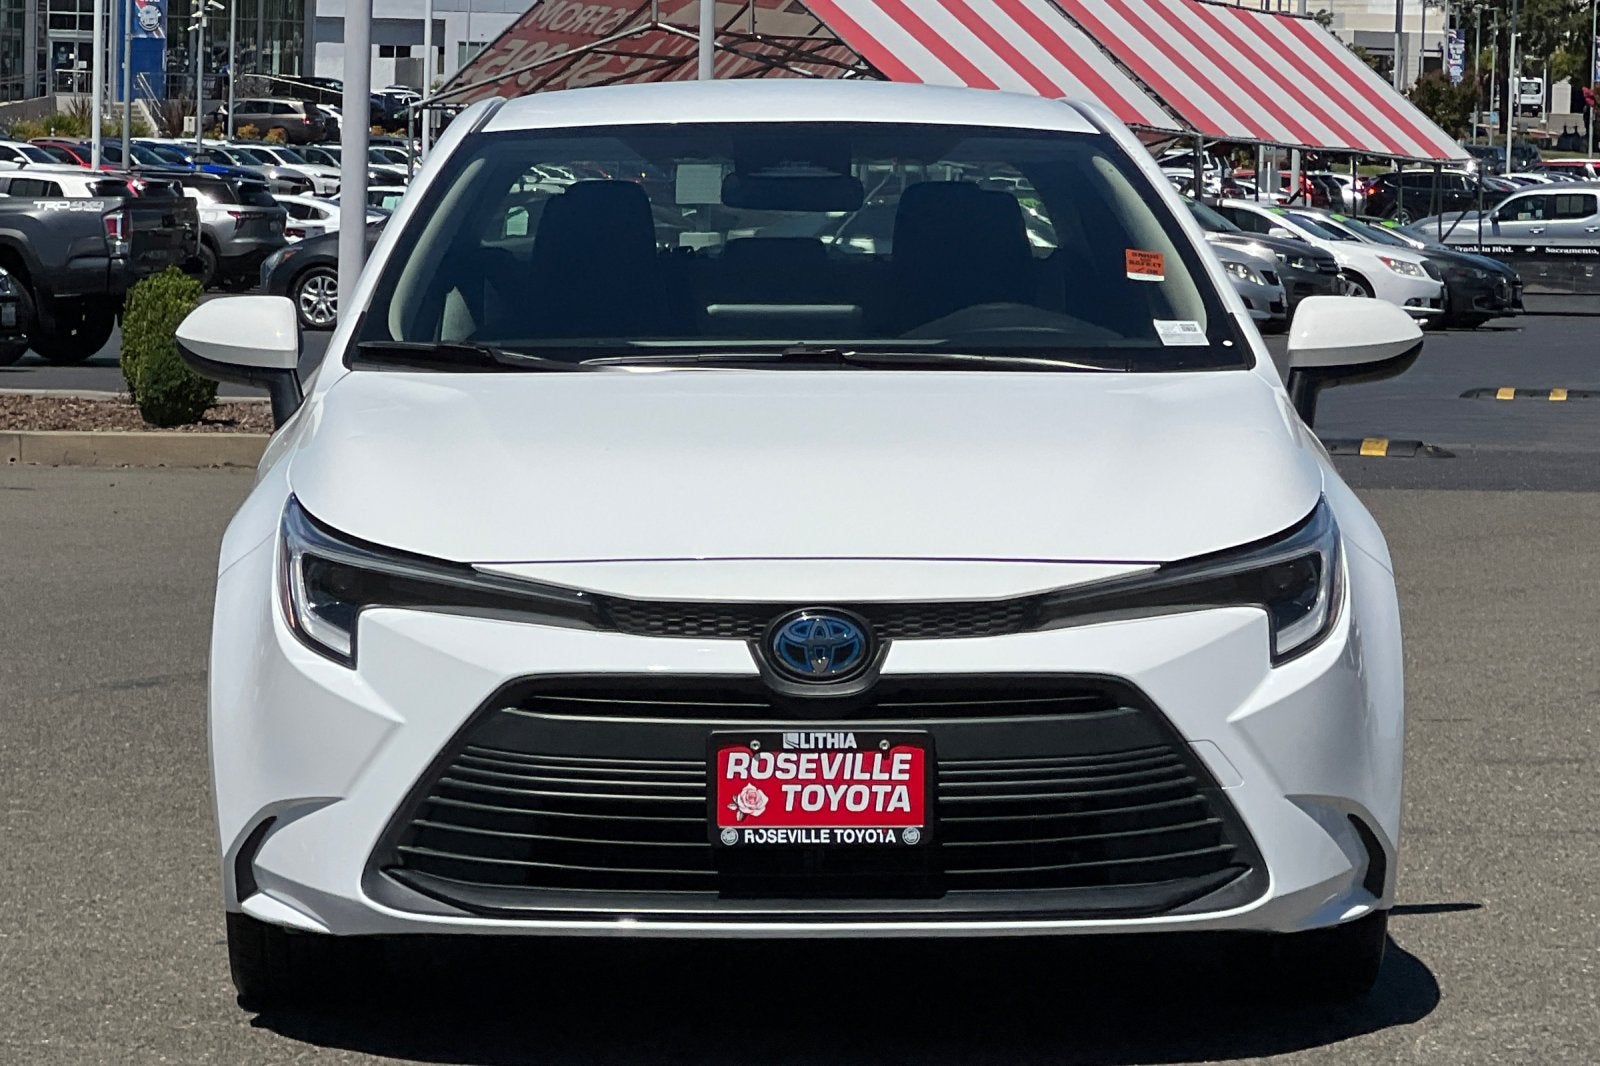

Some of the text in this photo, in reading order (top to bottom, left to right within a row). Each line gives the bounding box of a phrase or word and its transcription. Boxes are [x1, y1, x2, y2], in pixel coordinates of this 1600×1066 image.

[1545, 246, 1600, 254] Sacramento,
[799, 733, 857, 748] LITHIA
[726, 752, 912, 781] ROSEVILLE
[782, 784, 911, 812] TOYOTA
[744, 829, 896, 844] ROSEVILLE TOYOTA
